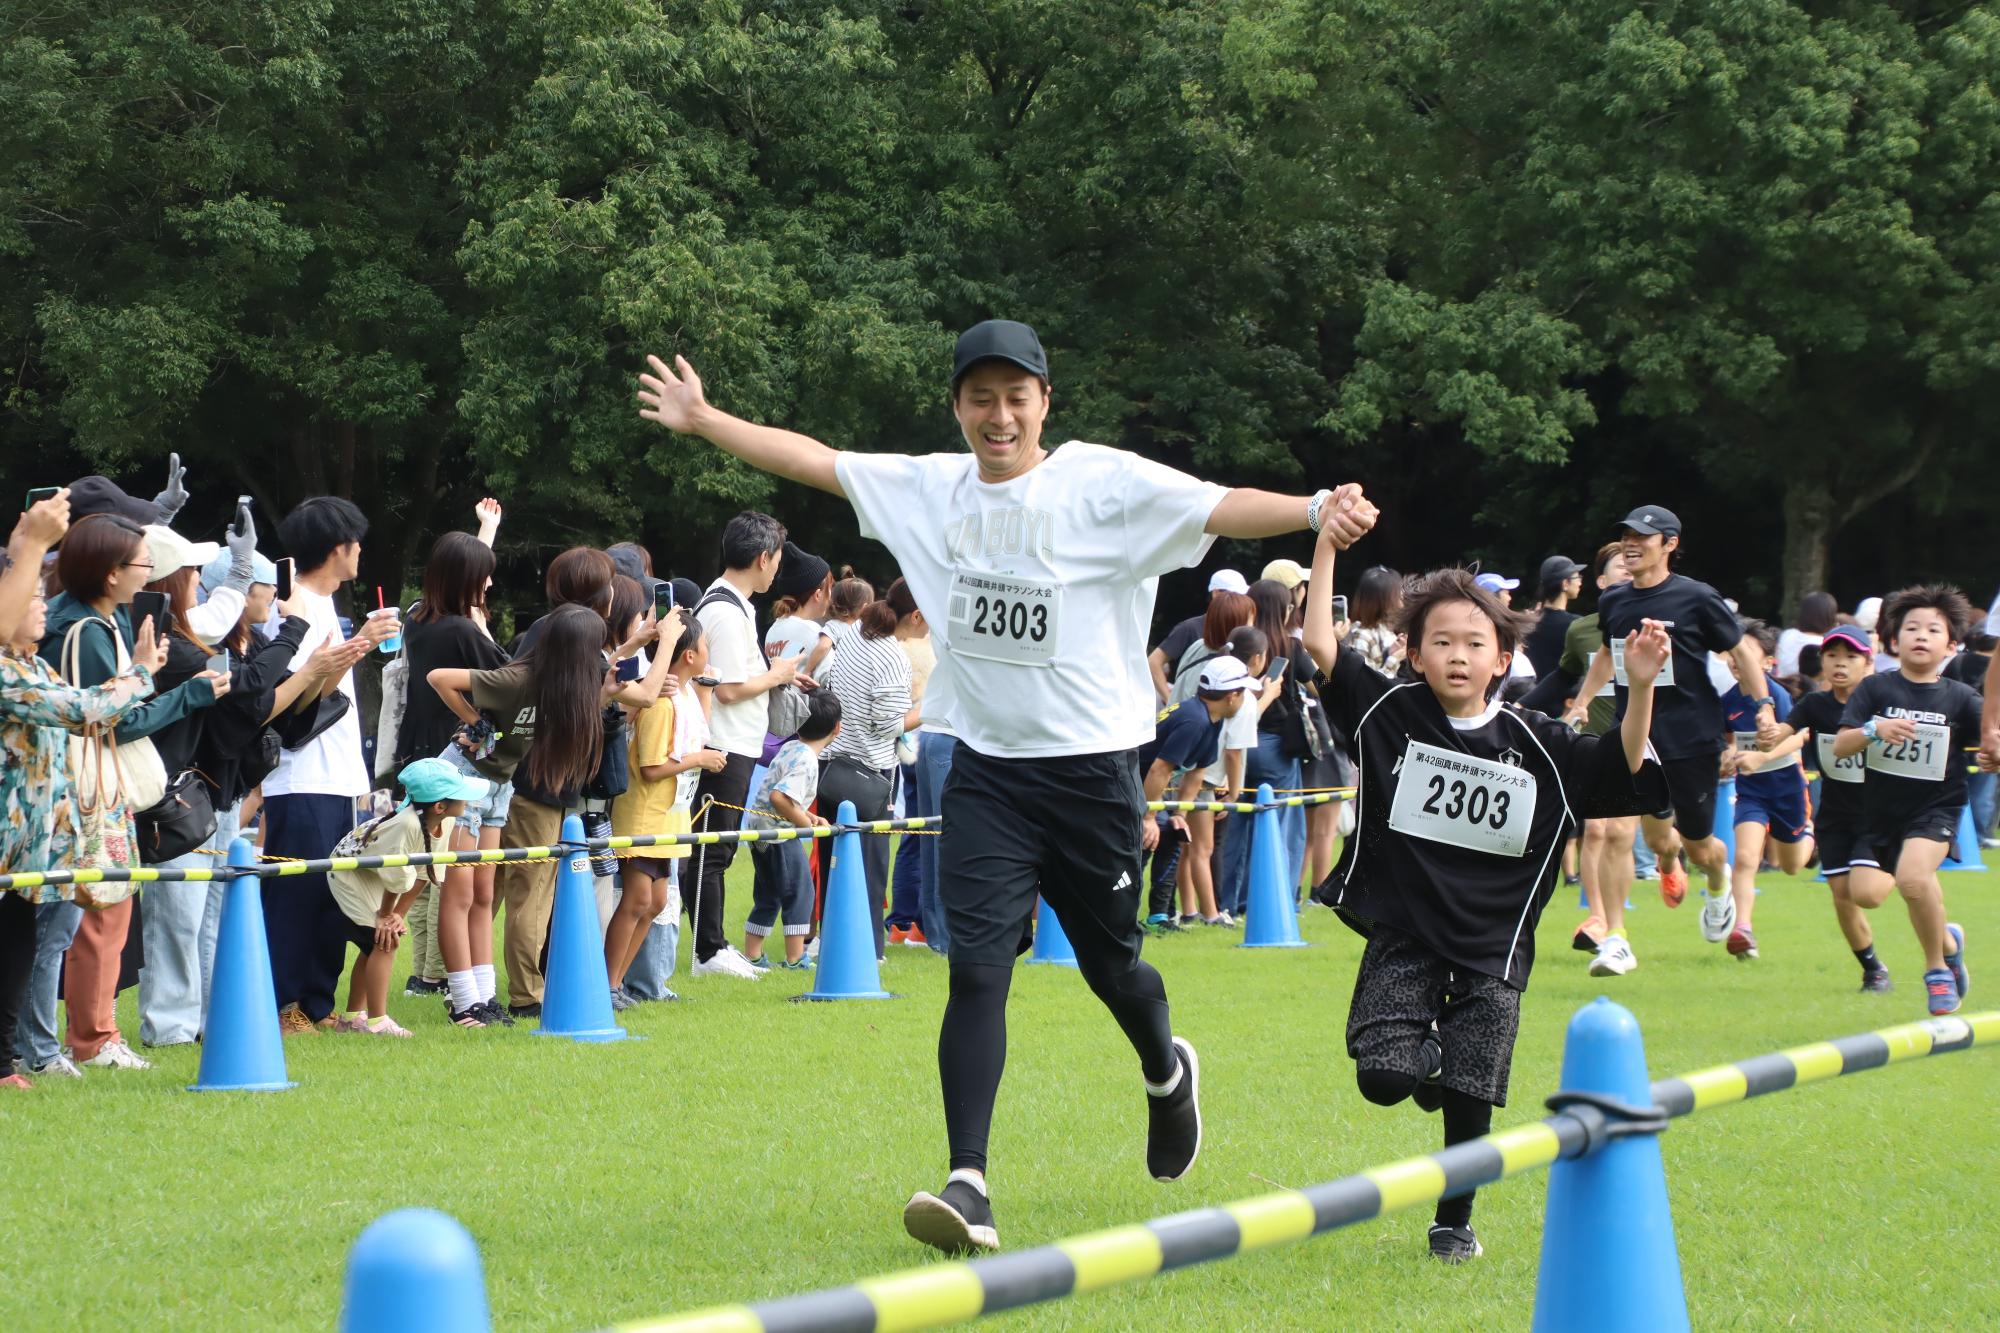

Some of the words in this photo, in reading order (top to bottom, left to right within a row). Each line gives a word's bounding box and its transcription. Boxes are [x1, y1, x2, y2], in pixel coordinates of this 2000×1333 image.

[973, 595, 1048, 642] 2303
[1886, 706, 1947, 725] UNDER
[1883, 738, 1933, 765] 2251
[1415, 752, 1528, 789] 第42回真岡井頭マラソン大会
[1422, 774, 1511, 830] 2303
